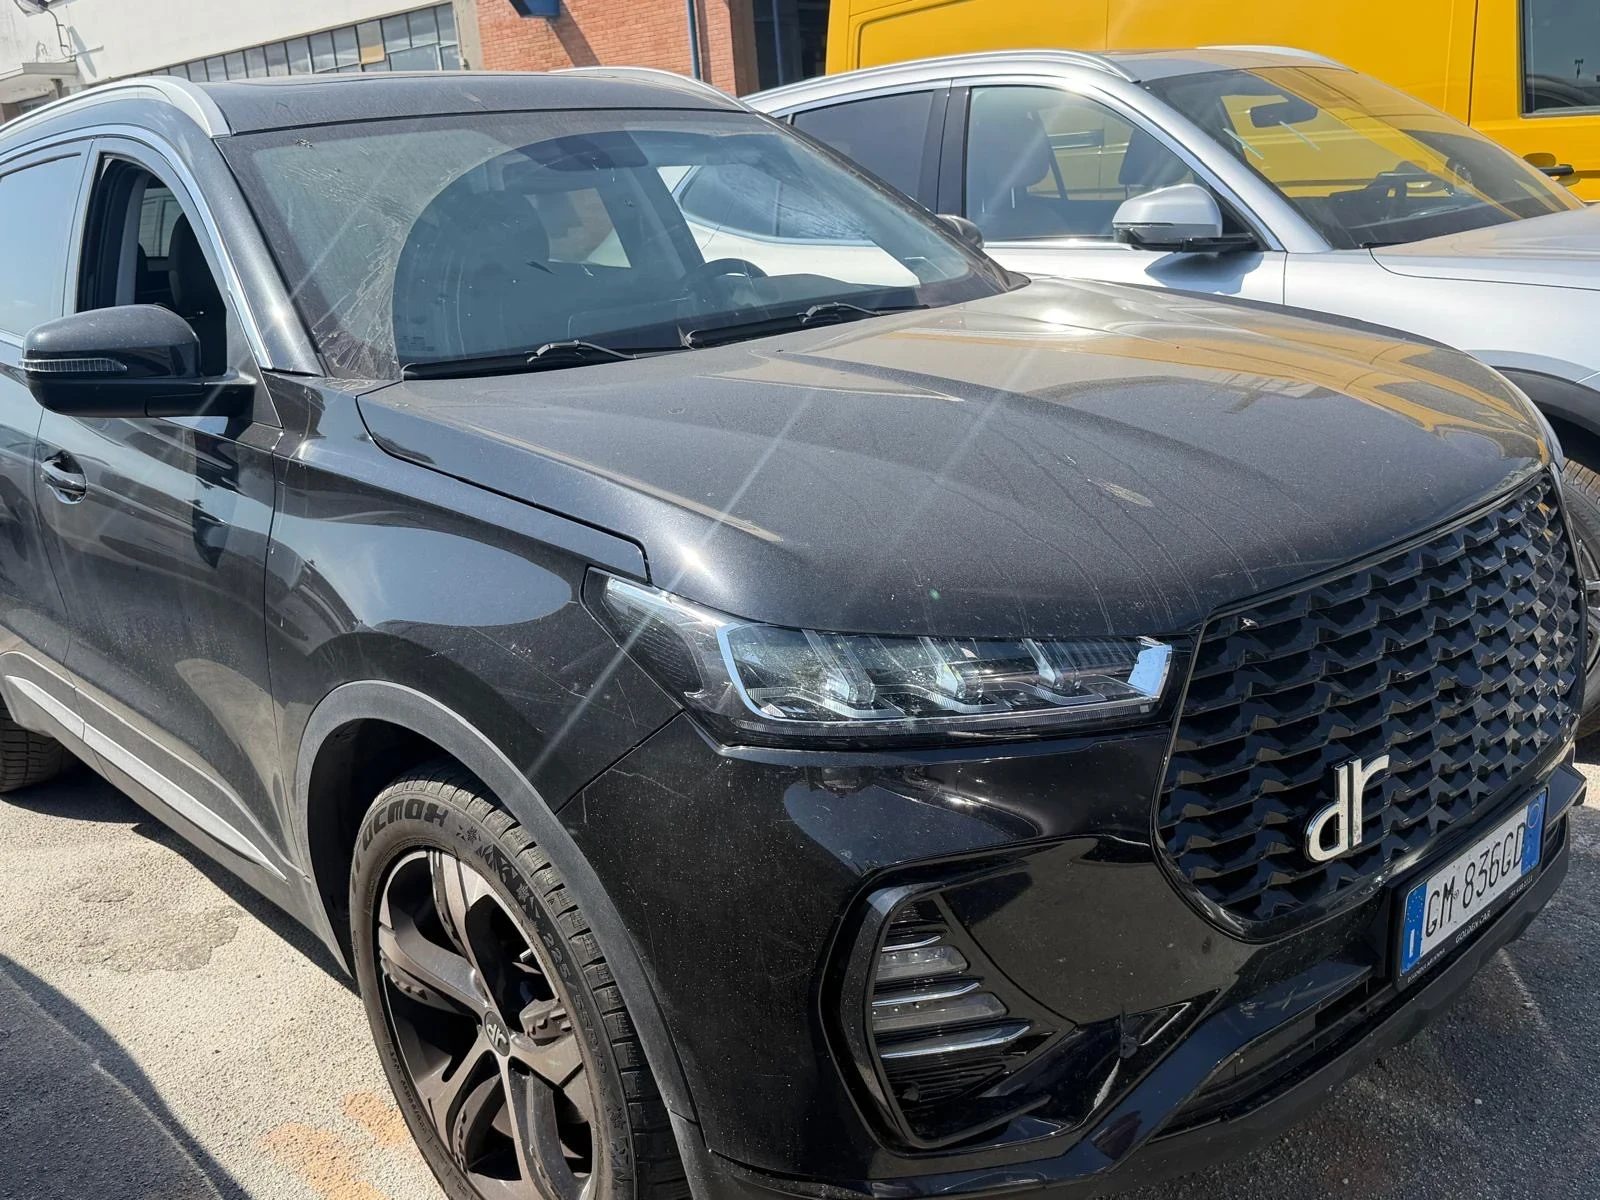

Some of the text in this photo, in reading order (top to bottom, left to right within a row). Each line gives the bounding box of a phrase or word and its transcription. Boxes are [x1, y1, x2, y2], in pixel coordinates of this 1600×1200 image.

[1305, 754, 1390, 861] dr
[1426, 876, 1455, 938] GM
[1463, 822, 1526, 909] 836GD
